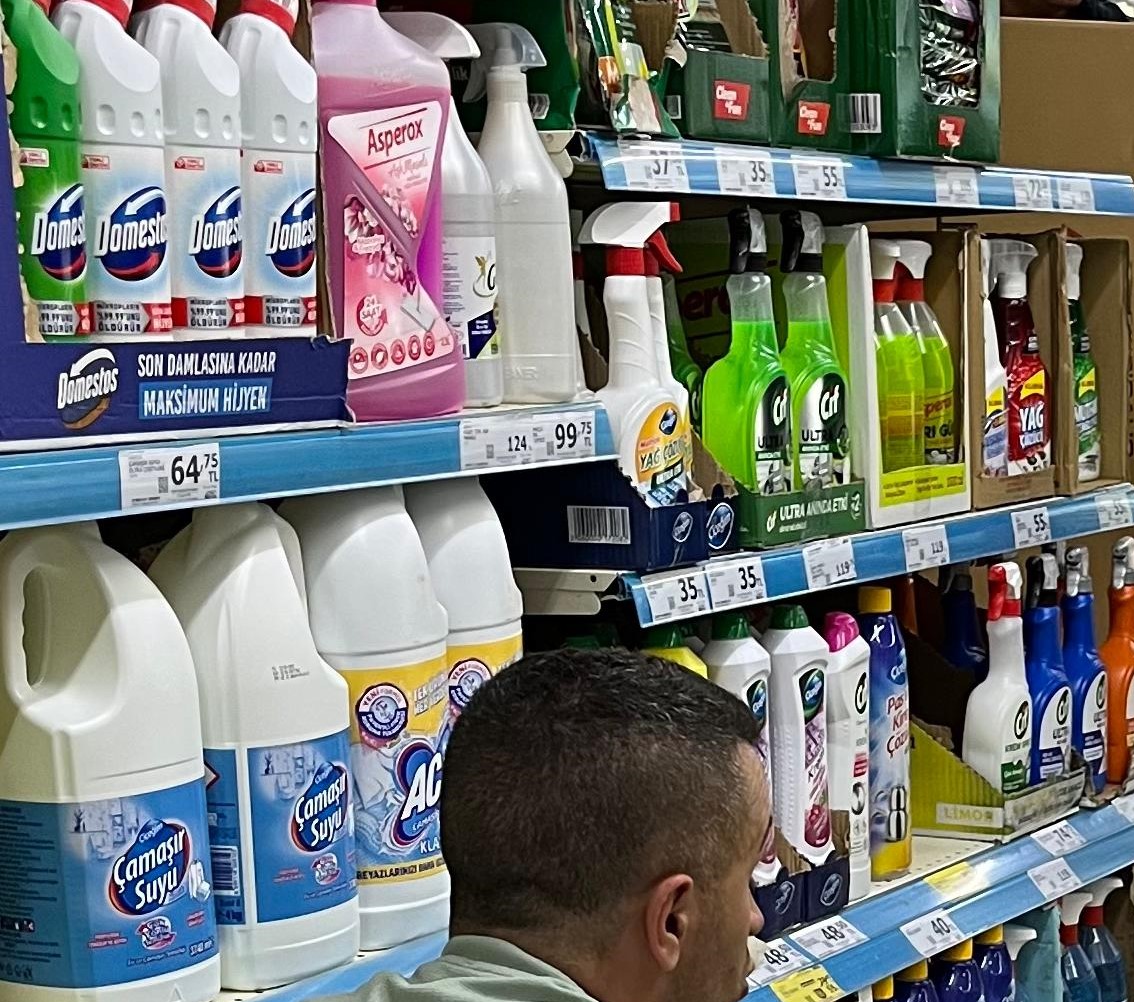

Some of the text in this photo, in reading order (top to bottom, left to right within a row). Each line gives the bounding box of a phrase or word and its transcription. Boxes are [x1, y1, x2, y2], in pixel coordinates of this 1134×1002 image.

[367, 118, 424, 156] Asperox
[822, 165, 838, 187] 55
[137, 351, 277, 378] SON DAMLASINA KADAR
[56, 365, 119, 410] Domestos
[143, 381, 268, 417] MAKSİMUM HİJYEN
[819, 384, 840, 421] Cif
[507, 434, 528, 452] 124
[208, 470, 219, 483] TL
[766, 509, 777, 533] Cif
[779, 499, 806, 522] ULTRA
[1033, 512, 1048, 533] 55
[738, 565, 757, 591] 35
[835, 560, 851, 578] 119
[678, 577, 698, 603] 35
[294, 772, 347, 832] Çamaşır
[400, 751, 443, 821] AC
[310, 806, 343, 848] Suyu
[113, 829, 187, 894] Çamaşır
[134, 867, 178, 910] Suyu
[929, 916, 951, 936] 40
